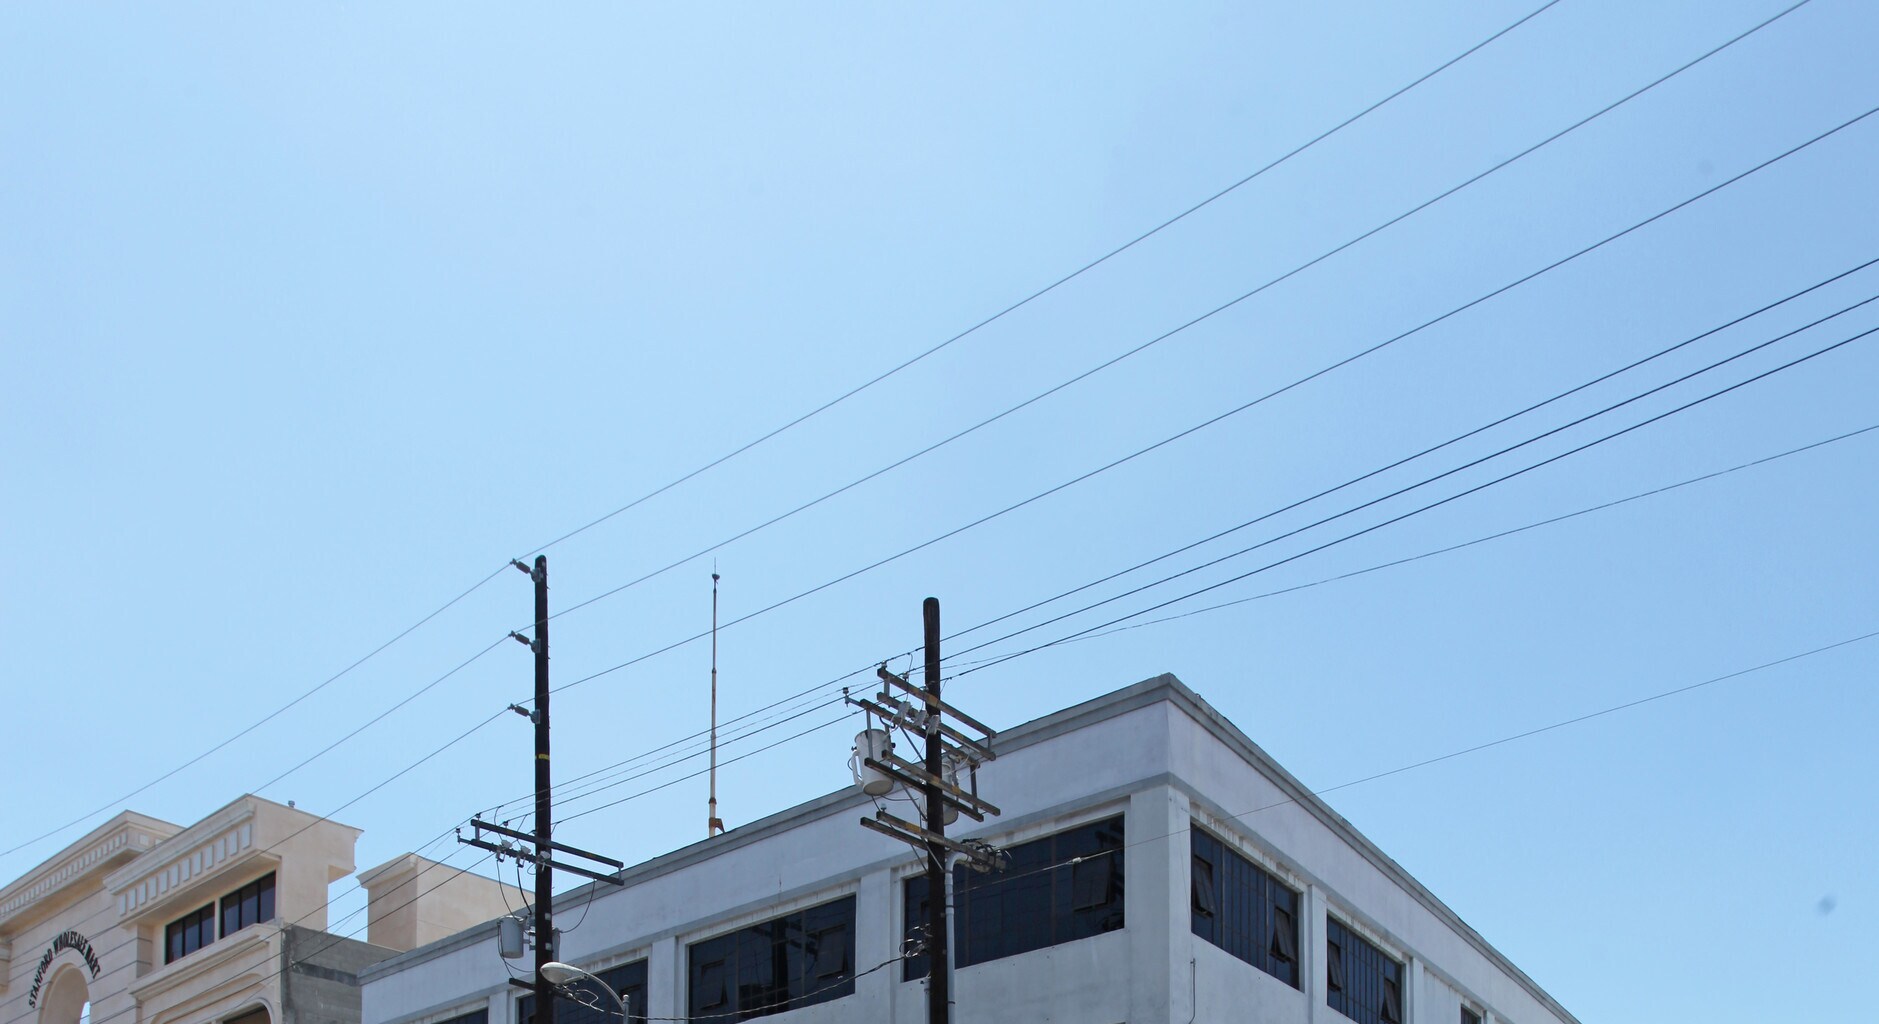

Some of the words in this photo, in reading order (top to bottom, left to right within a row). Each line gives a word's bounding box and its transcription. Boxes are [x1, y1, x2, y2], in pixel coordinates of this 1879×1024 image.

[28, 948, 54, 1009] STANFORD
[53, 930, 88, 956] WHOLESALE
[84, 944, 101, 979] MART
